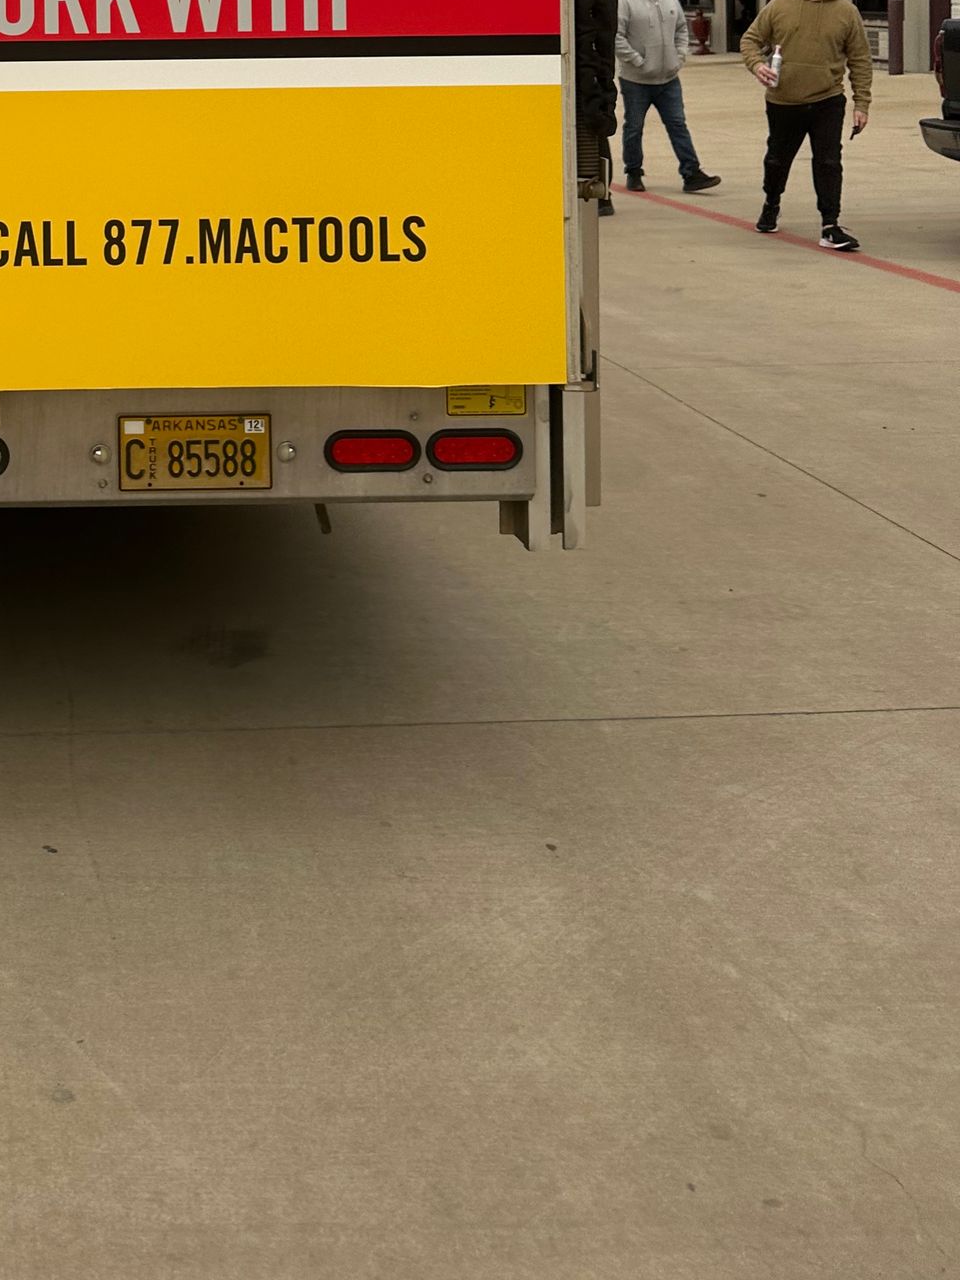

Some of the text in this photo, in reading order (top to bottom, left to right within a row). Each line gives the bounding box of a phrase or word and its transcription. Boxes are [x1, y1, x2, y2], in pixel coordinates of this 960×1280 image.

[103, 216, 428, 265] 877.MACTOOLS
[151, 418, 238, 431] ARKANSAS
[247, 419, 260, 429] 12
[125, 438, 145, 480] C
[148, 438, 157, 480] TRUCK
[167, 438, 257, 479] 85588
